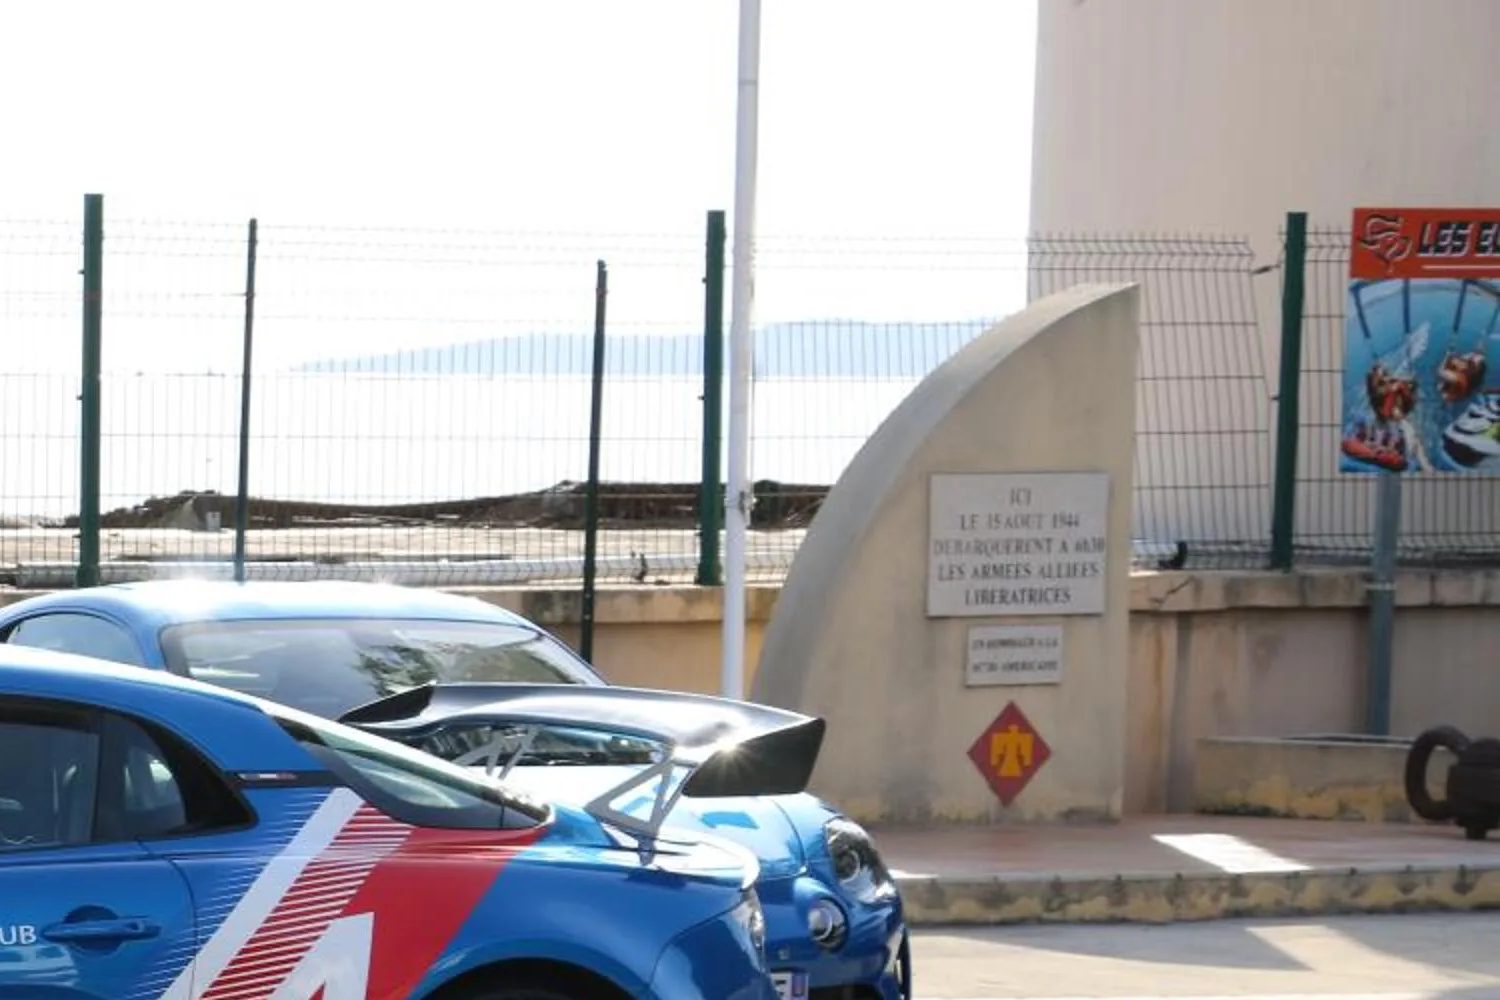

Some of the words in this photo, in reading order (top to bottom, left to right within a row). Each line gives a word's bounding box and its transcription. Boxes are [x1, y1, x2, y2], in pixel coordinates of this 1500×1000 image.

[1417, 221, 1474, 257] LES
[1010, 487, 1032, 507] ICI
[958, 514, 980, 531] LE
[1052, 510, 1081, 529] 1944
[937, 564, 966, 582] LES
[964, 587, 1072, 607] LIBERATRICES
